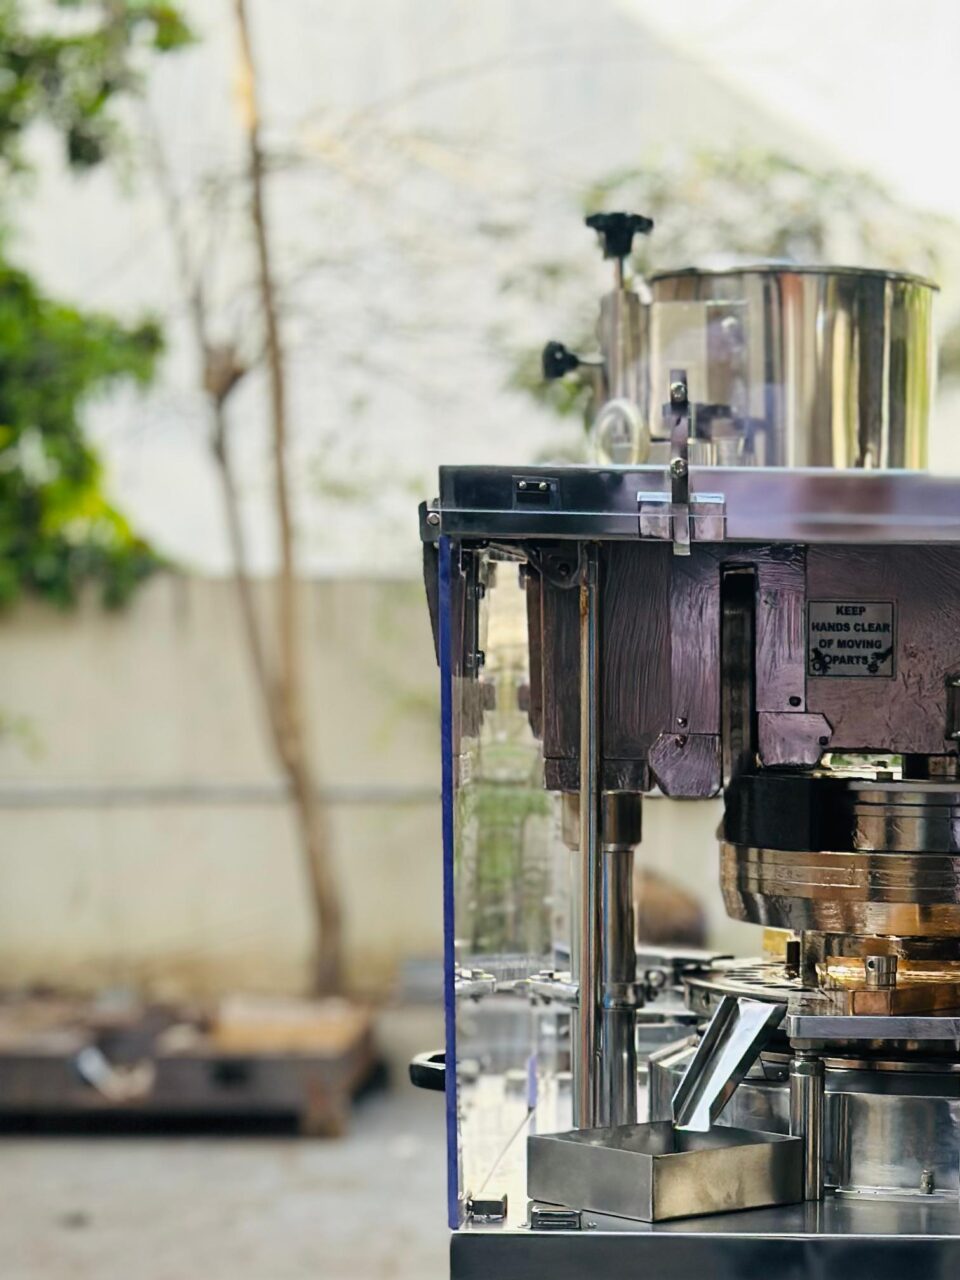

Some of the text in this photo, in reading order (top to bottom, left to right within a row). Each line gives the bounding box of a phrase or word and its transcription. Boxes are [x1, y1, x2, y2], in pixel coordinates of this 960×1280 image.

[836, 606, 866, 616] KEEP
[811, 622, 890, 632] HANDS CLEAR
[819, 639, 882, 649] OF MOVING
[833, 655, 868, 665] PARTS
